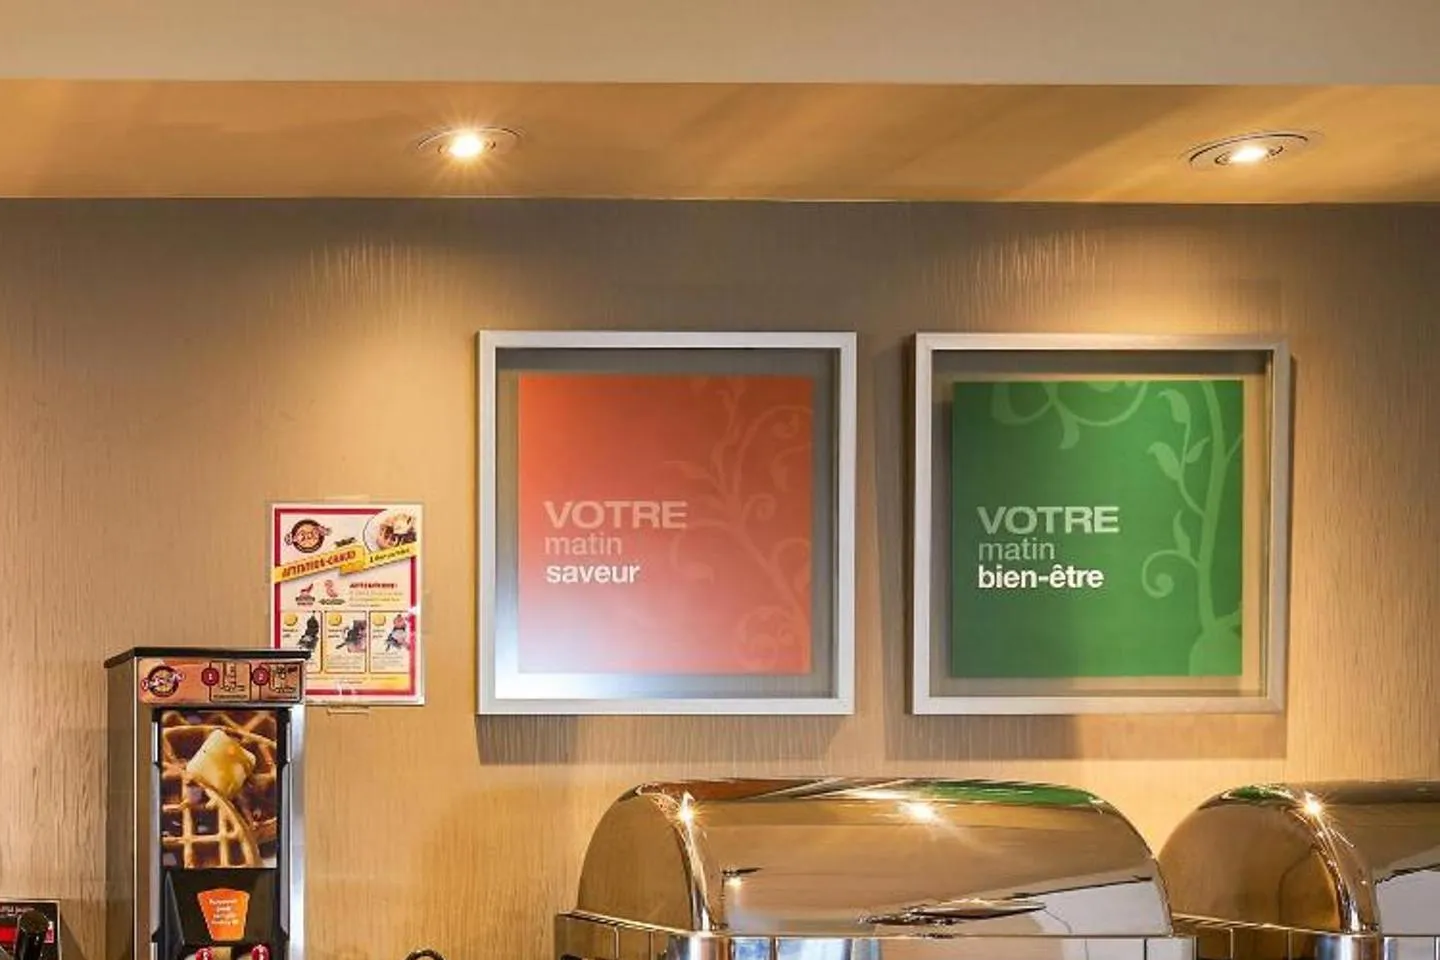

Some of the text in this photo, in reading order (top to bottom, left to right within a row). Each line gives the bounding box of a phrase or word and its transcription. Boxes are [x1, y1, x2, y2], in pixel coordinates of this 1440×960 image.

[543, 501, 688, 529] VOTRE
[977, 505, 1120, 534] VOTRE
[545, 531, 622, 555] matin
[978, 537, 1055, 561] matin
[546, 563, 640, 584] saveur
[978, 564, 1104, 589] bien-être
